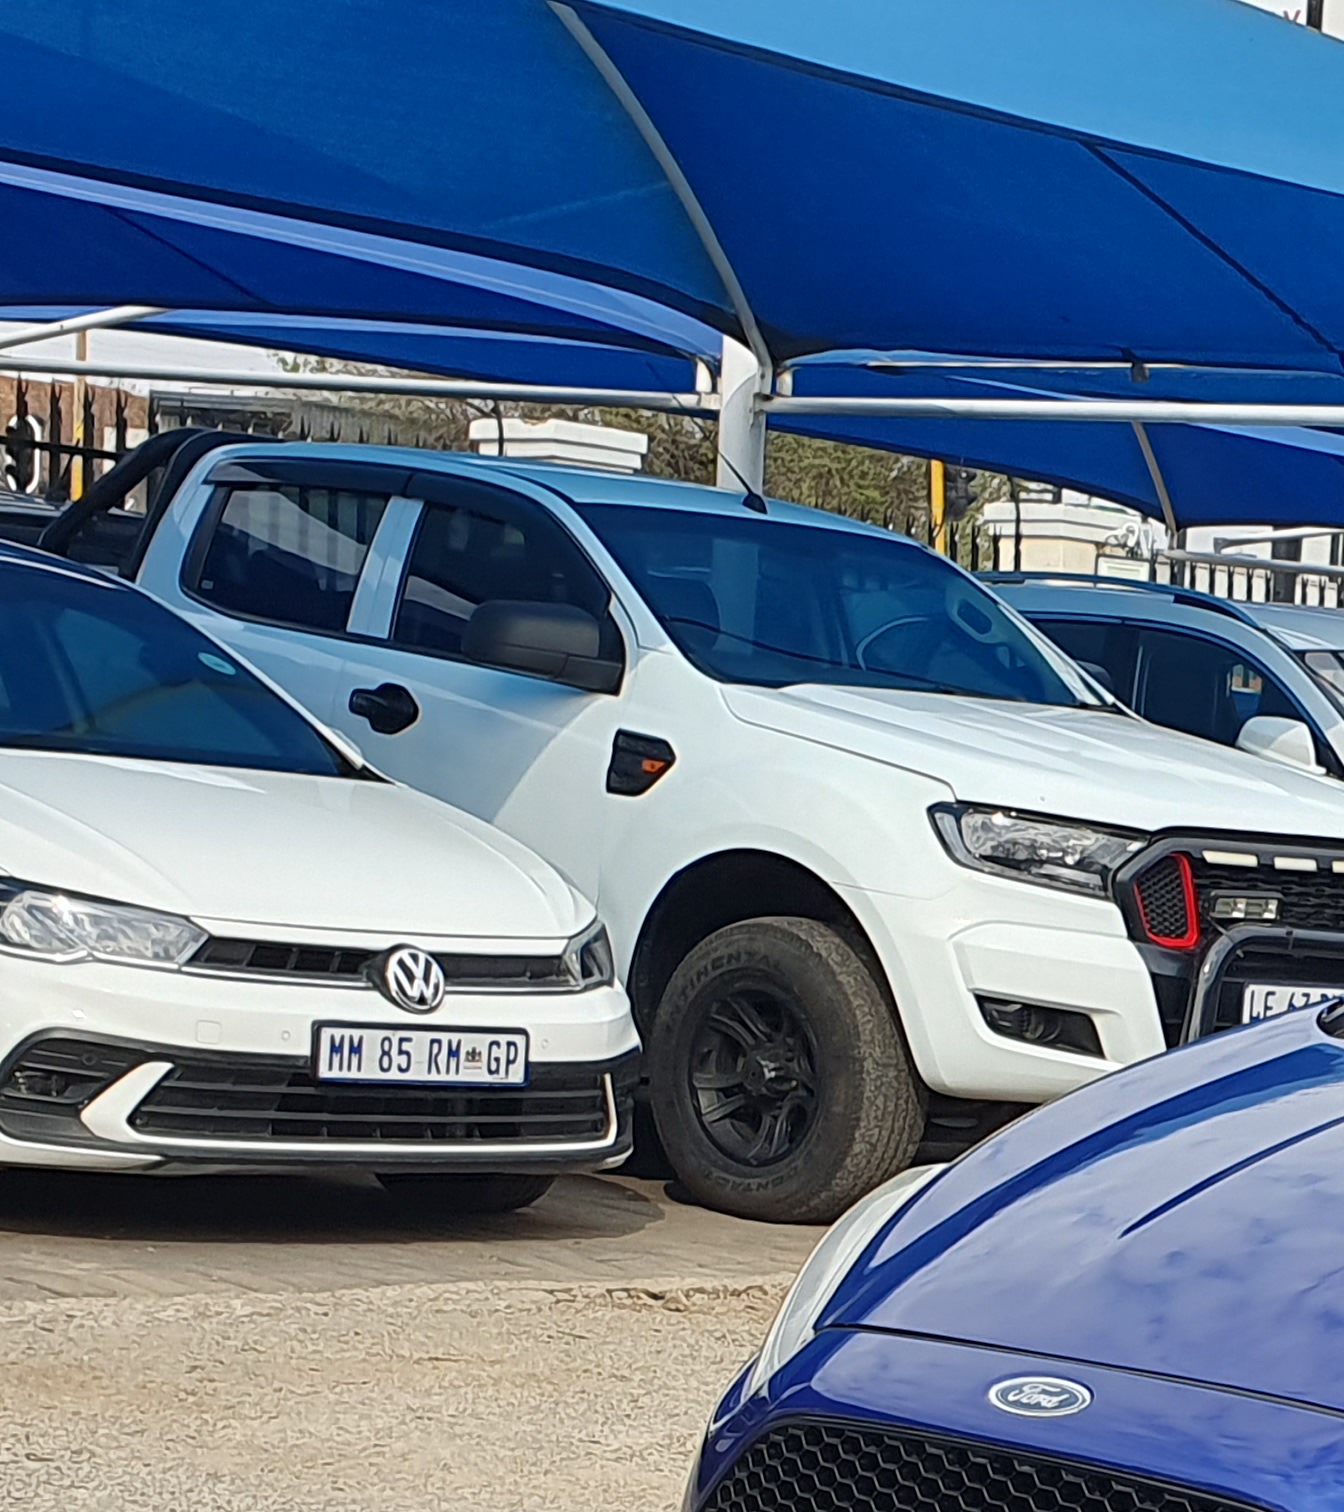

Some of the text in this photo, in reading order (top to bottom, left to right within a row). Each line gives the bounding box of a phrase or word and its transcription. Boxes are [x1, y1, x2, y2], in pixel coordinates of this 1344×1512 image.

[327, 1032, 519, 1079] MM 85 RM GP
[1006, 1382, 1071, 1409] Ford
